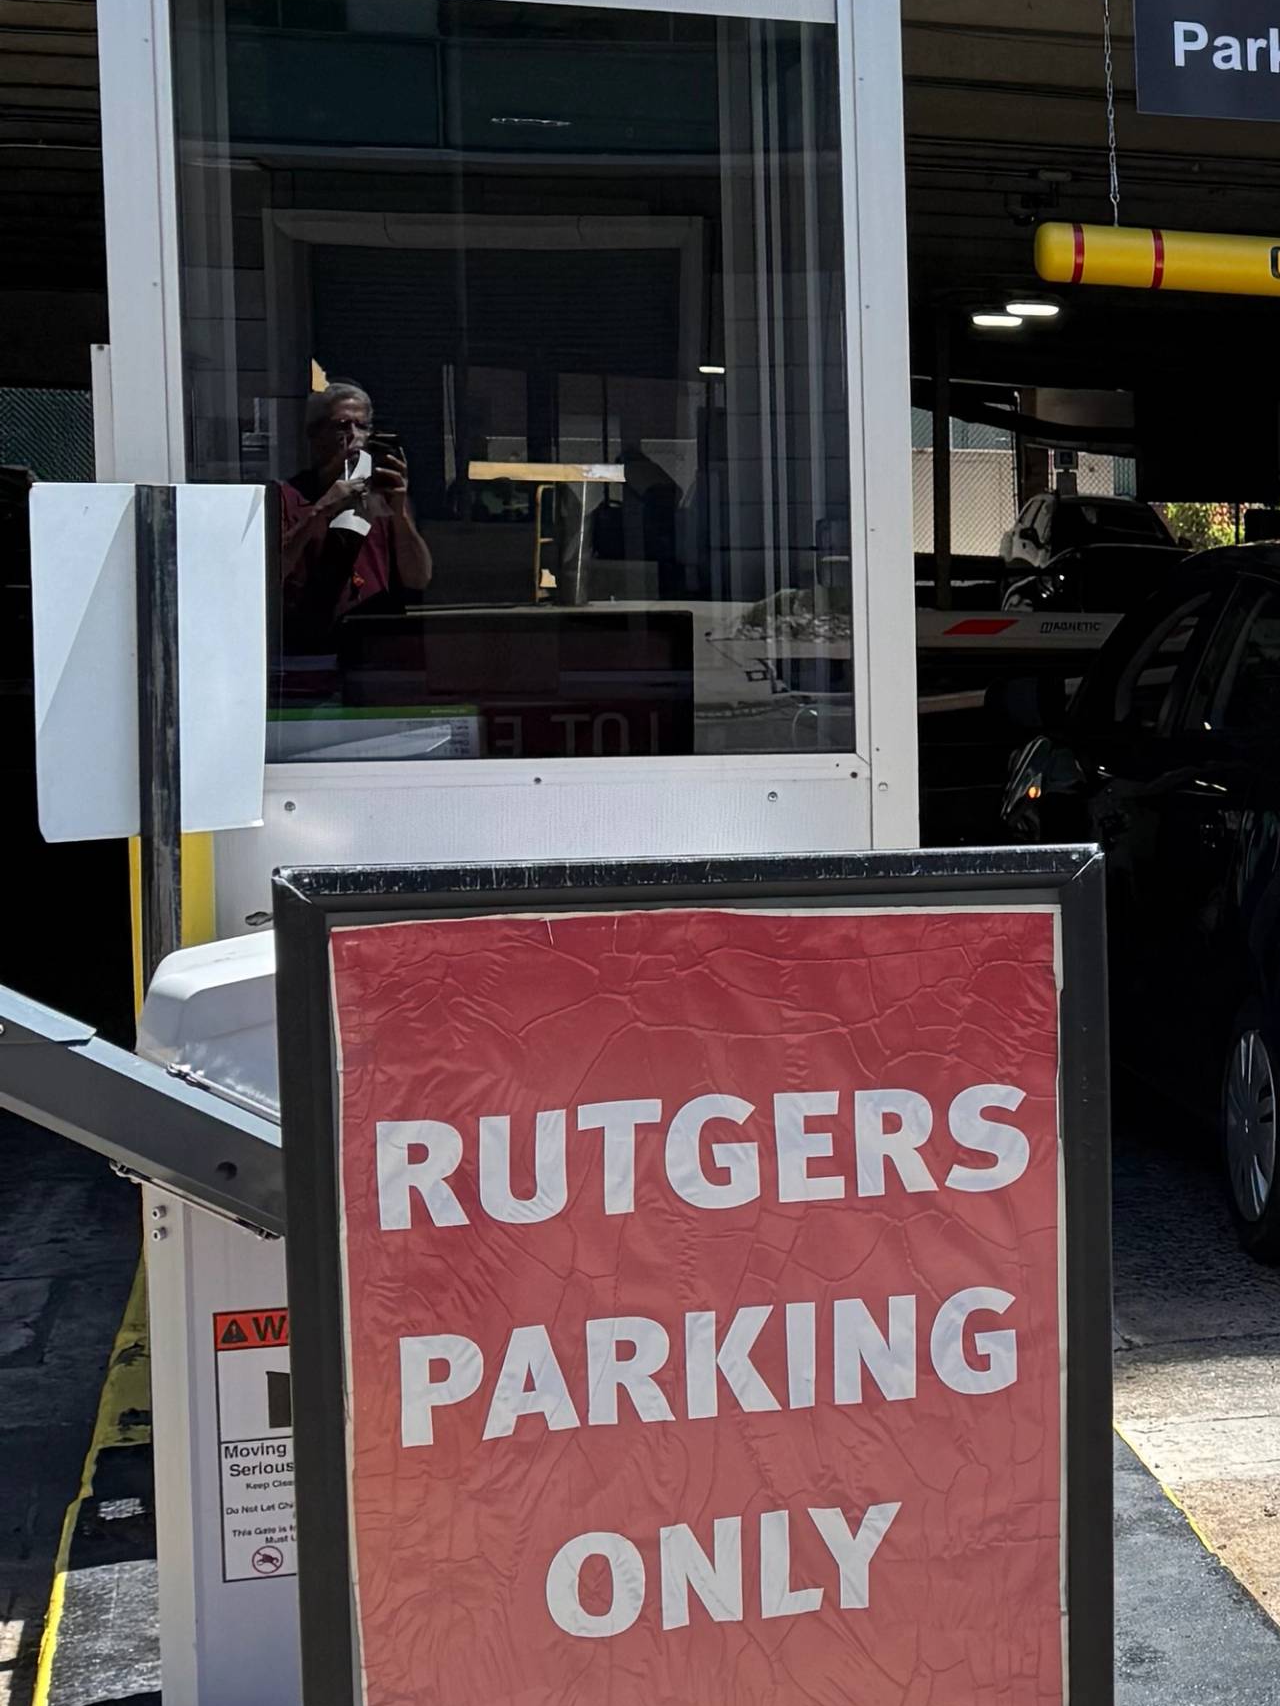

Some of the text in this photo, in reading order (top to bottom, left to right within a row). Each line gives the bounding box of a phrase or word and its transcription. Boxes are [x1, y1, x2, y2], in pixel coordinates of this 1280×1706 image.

[375, 1084, 1031, 1231] RUTGERS
[399, 1286, 1018, 1448] PARKING
[224, 1442, 287, 1459] Moving
[229, 1461, 294, 1477] Serious
[246, 1480, 294, 1491] Keep Clea
[226, 1507, 239, 1515] Do
[241, 1505, 258, 1514] Not
[261, 1504, 275, 1512] Let
[232, 1529, 252, 1537] This
[254, 1527, 274, 1535] Gate
[278, 1525, 287, 1533] is
[265, 1535, 288, 1544] Must
[546, 1502, 902, 1638] ONLY
